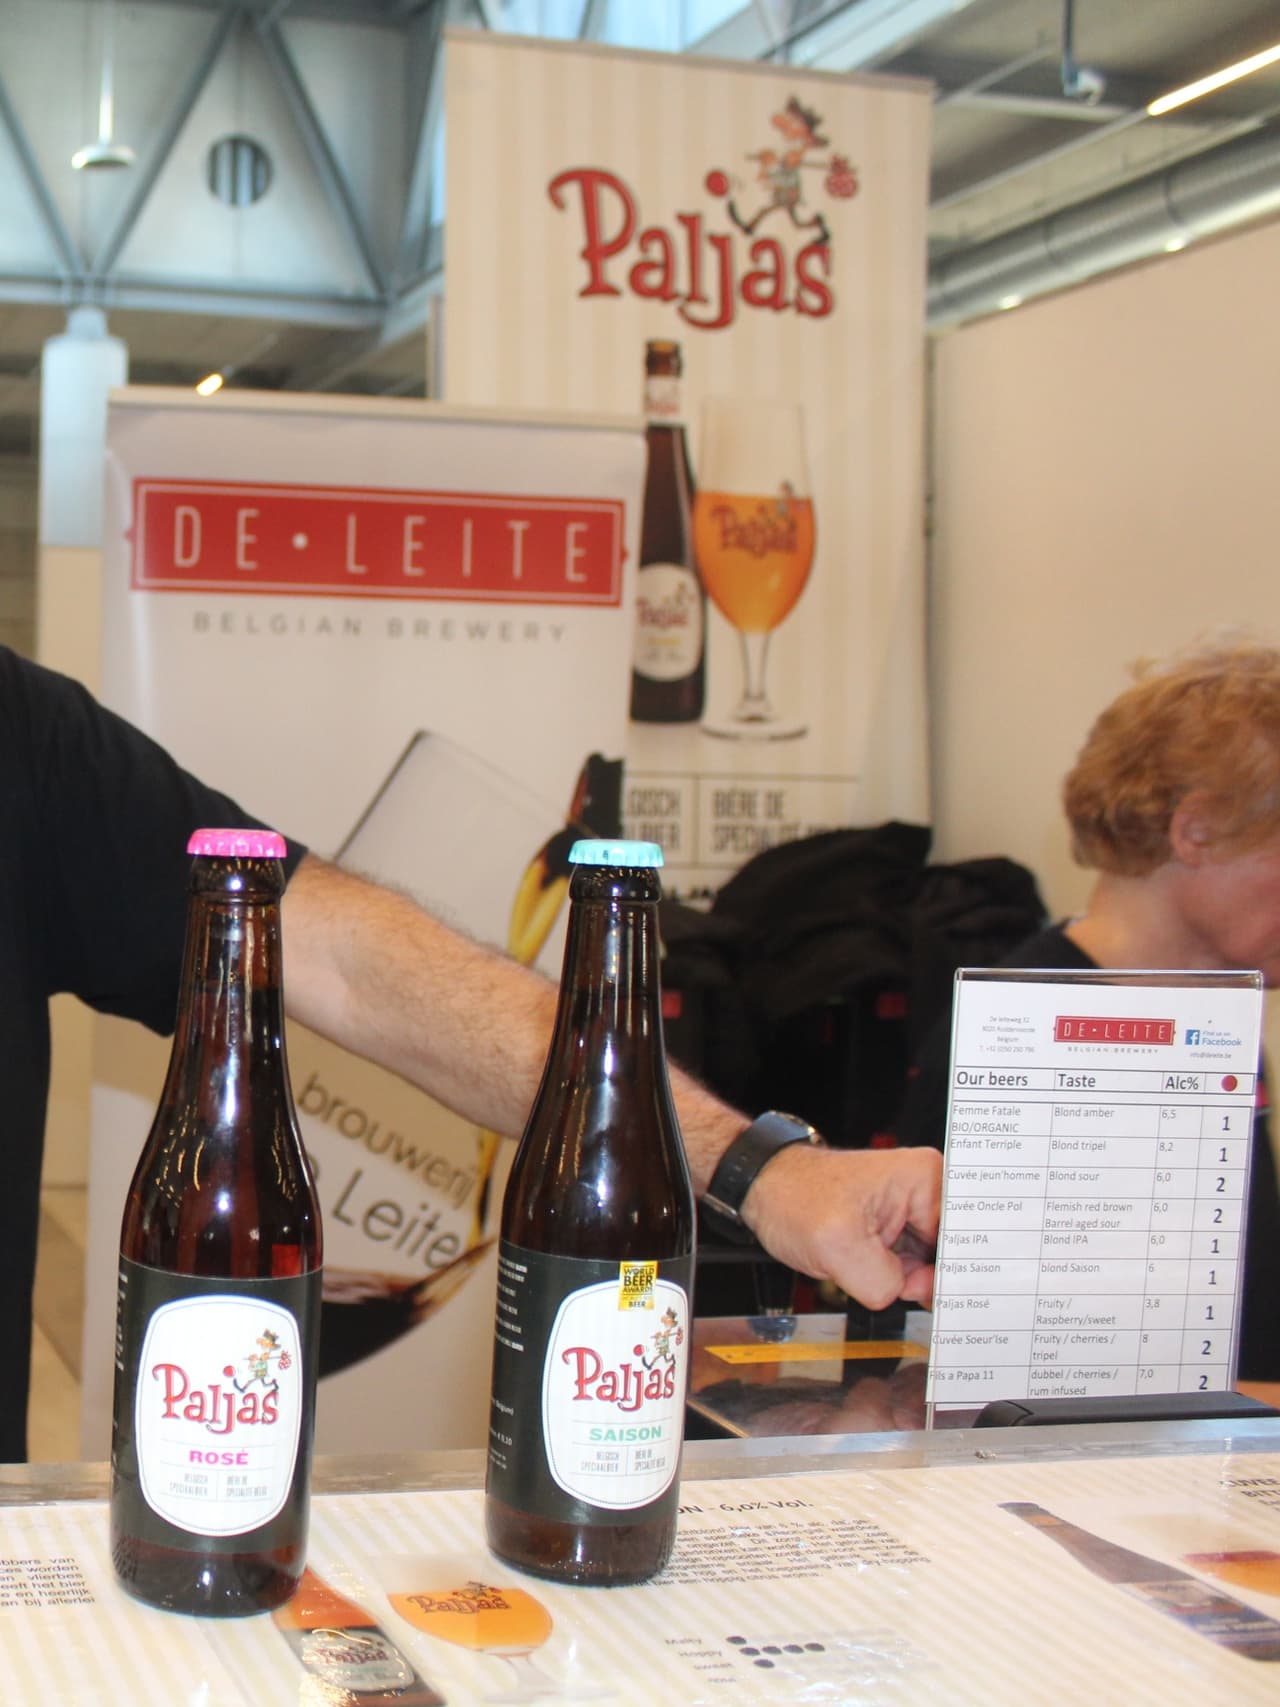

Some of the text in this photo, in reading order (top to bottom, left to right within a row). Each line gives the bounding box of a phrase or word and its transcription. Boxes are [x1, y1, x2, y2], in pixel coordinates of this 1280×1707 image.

[547, 167, 834, 331] Paljas
[173, 506, 589, 582] DE LEITE
[193, 612, 567, 644] BELGIAN BREWERY
[1063, 1022, 1166, 1040] DE LEITE
[1202, 1038, 1242, 1046] Facebook
[956, 1071, 1028, 1087] Our beers
[1057, 1073, 1096, 1087] Taste
[1165, 1076, 1199, 1090] Alc%
[952, 1105, 1021, 1117] Femme Fatale
[1054, 1107, 1115, 1118] Blond amber
[1161, 1109, 1176, 1120] 6,5
[951, 1122, 1020, 1133] BIO/ORGANIC
[1222, 1116, 1231, 1131] 1
[950, 1138, 1022, 1150] Enfant Terriple
[1051, 1140, 1106, 1151] Blond tripel
[1159, 1142, 1174, 1152] 8,2
[1219, 1147, 1228, 1162] 1
[947, 1169, 978, 1180] Cuvée
[1049, 1171, 1099, 1181] Blond sour
[1156, 1172, 1171, 1183] 6,0
[1216, 1177, 1225, 1192] 2
[977, 1201, 1005, 1211] Oncle
[1007, 1201, 1022, 1211] Pol
[1046, 1201, 1133, 1212] Flemish red brown
[1153, 1202, 1168, 1214] 6,0
[331, 1167, 461, 1271] Leite
[1213, 1208, 1222, 1223] 2
[1045, 1218, 1121, 1231] Barrel aged sour
[943, 1234, 989, 1246] Paljas IPA
[1043, 1235, 1088, 1244] Blond IPA
[1150, 1235, 1165, 1246] 6,0
[1211, 1238, 1220, 1254] 1
[940, 1263, 1001, 1275] Paljas Saison
[1041, 1263, 1100, 1273] blond Saison
[623, 1275, 653, 1287] BEER
[1208, 1270, 1217, 1285] 1
[936, 1299, 964, 1310] Paljas
[1038, 1298, 1064, 1310] Fruity
[1145, 1298, 1160, 1309] 3,8
[1205, 1305, 1214, 1320] 1
[1036, 1315, 1116, 1326] Raspberry/sweet
[1034, 1334, 1109, 1345] Fruity cherries
[1201, 1340, 1211, 1355] 2
[1032, 1350, 1058, 1361] tripel
[561, 1344, 676, 1412] Paljas
[956, 1371, 980, 1382] Papa
[983, 1370, 994, 1380] 11
[1031, 1369, 1111, 1380] dubbel cherries
[1139, 1368, 1154, 1380] 7,0
[1199, 1375, 1208, 1390] 2
[1030, 1385, 1087, 1396] rum infused
[151, 1363, 280, 1435] Paljas
[589, 1425, 662, 1441] SAISON
[188, 1447, 249, 1466] ROSÉ
[719, 1499, 814, 1514] 6,0% Vol.
[406, 1591, 512, 1615] Paljas
